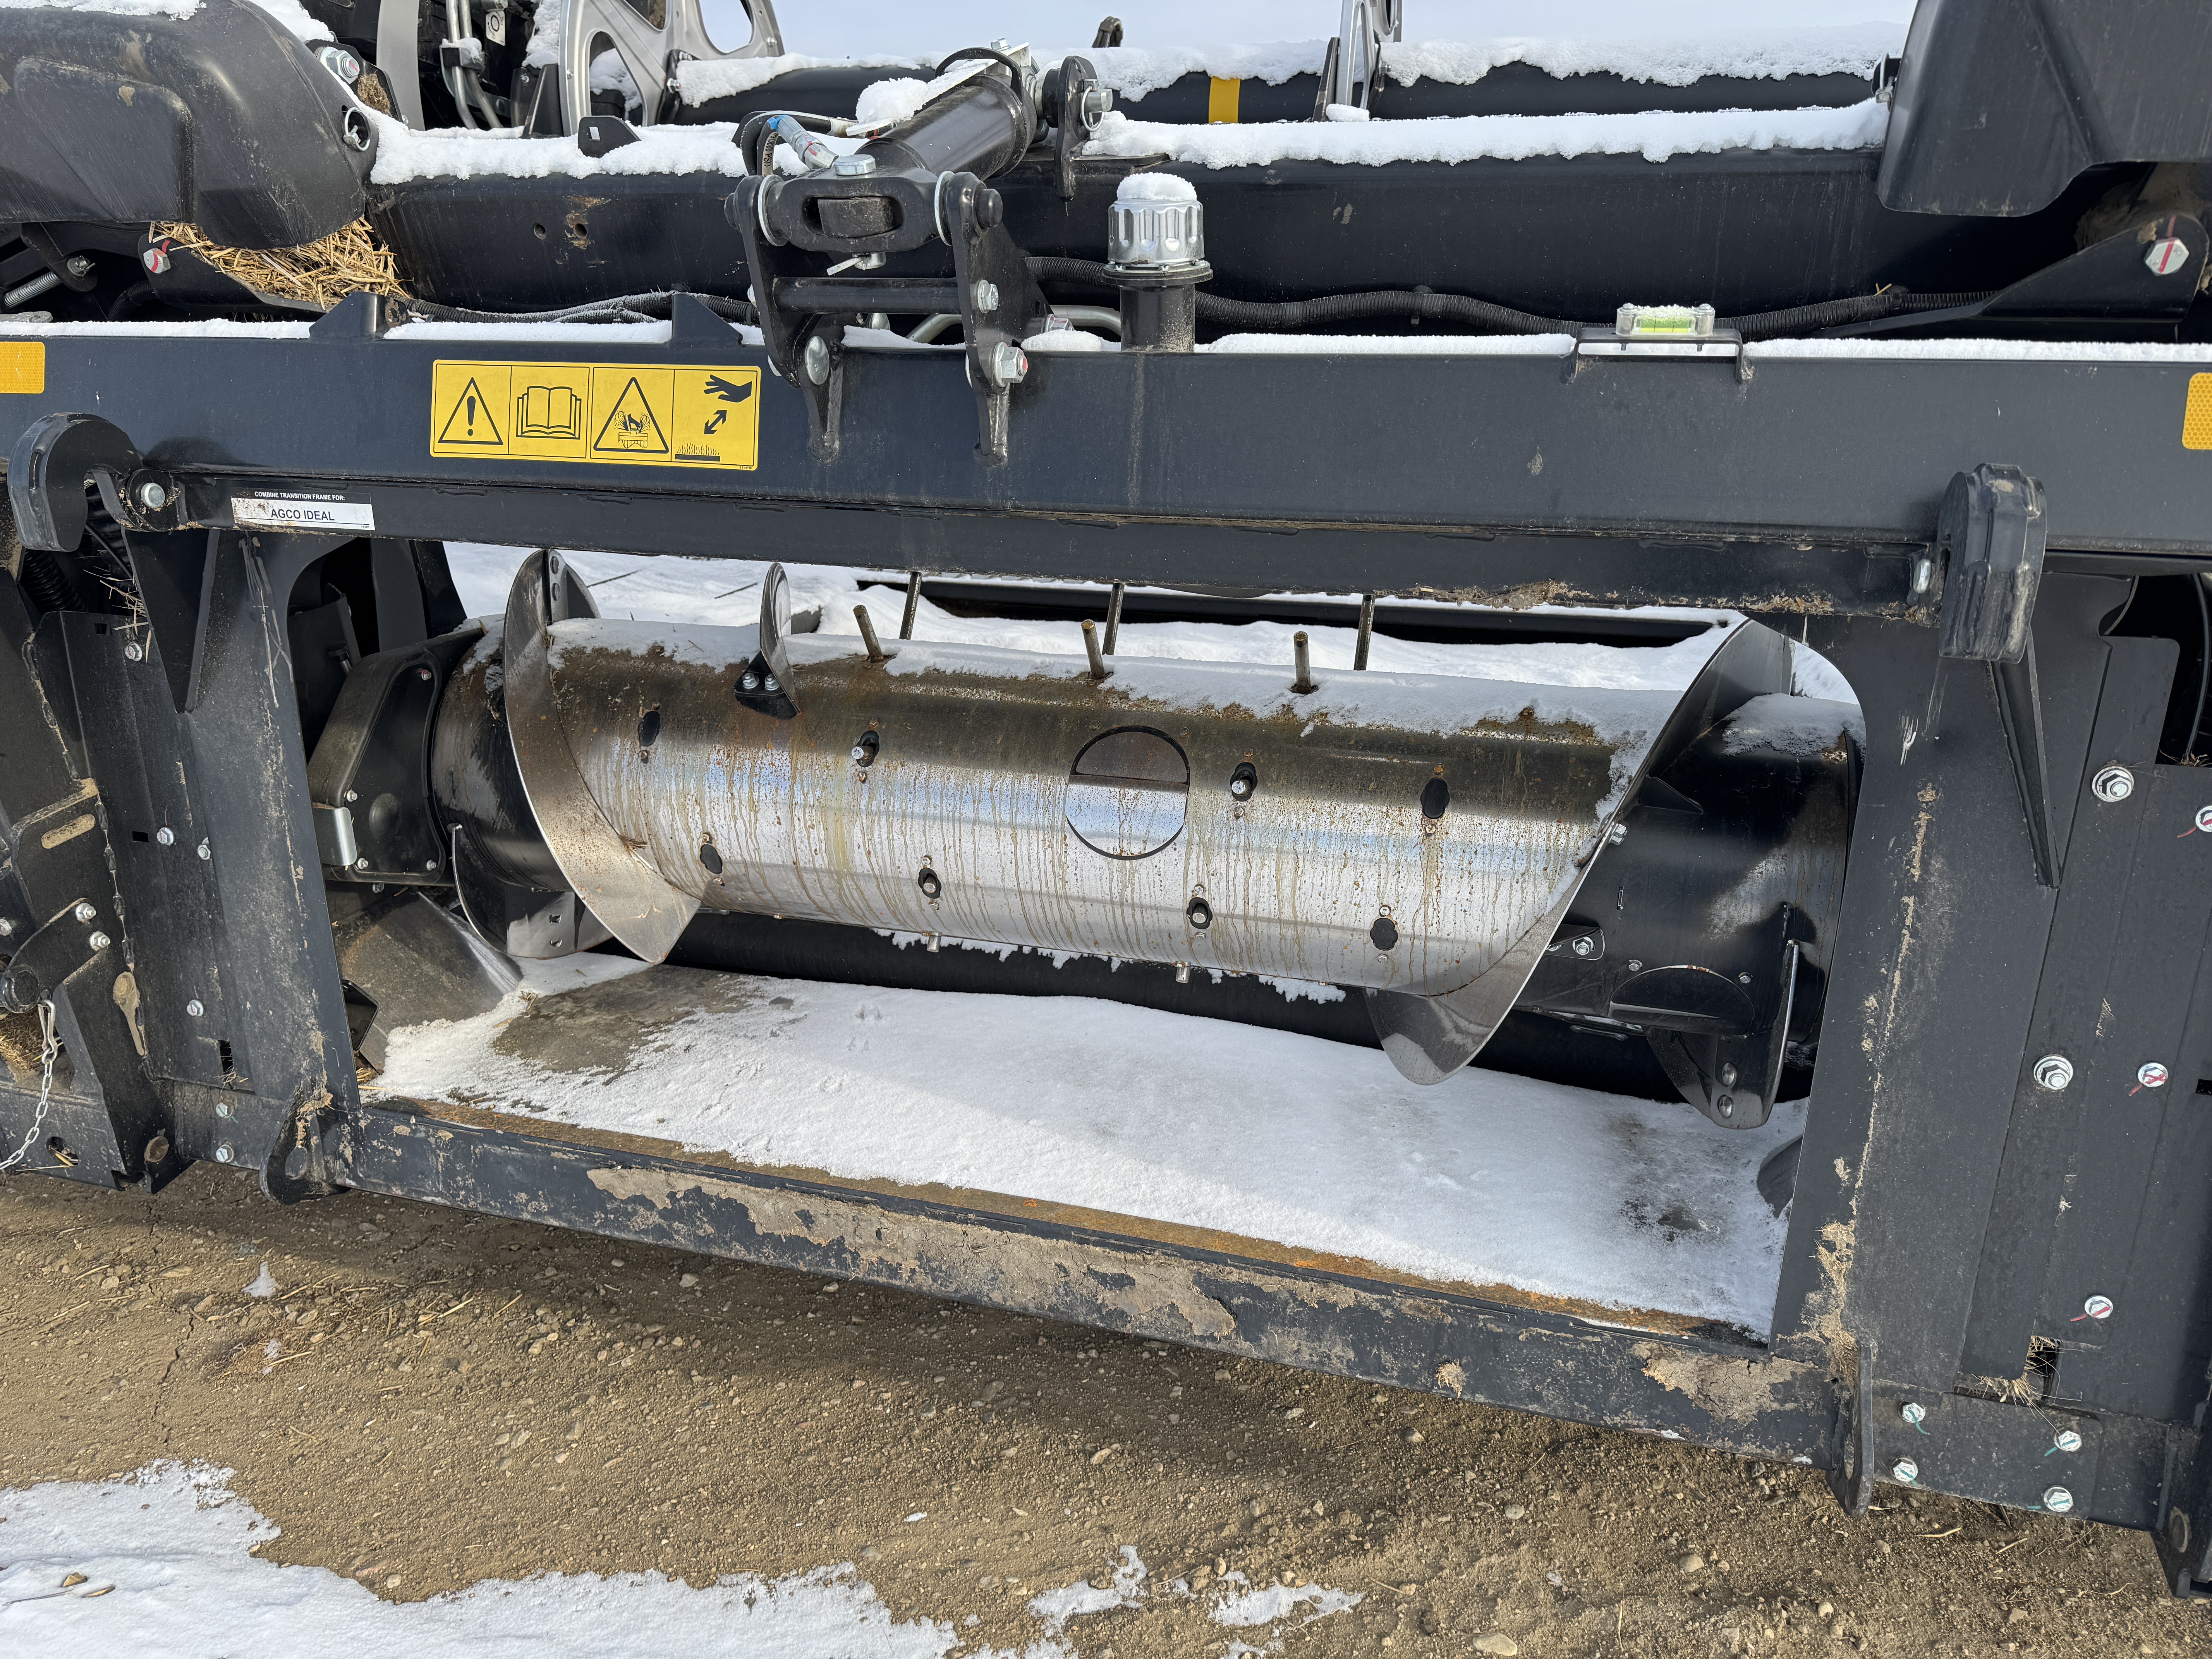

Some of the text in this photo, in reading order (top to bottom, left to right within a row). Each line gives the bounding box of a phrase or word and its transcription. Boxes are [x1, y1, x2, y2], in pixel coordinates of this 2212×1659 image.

[764, 153, 773, 167] PSI)
[271, 508, 335, 520] AGCO IDEAL
